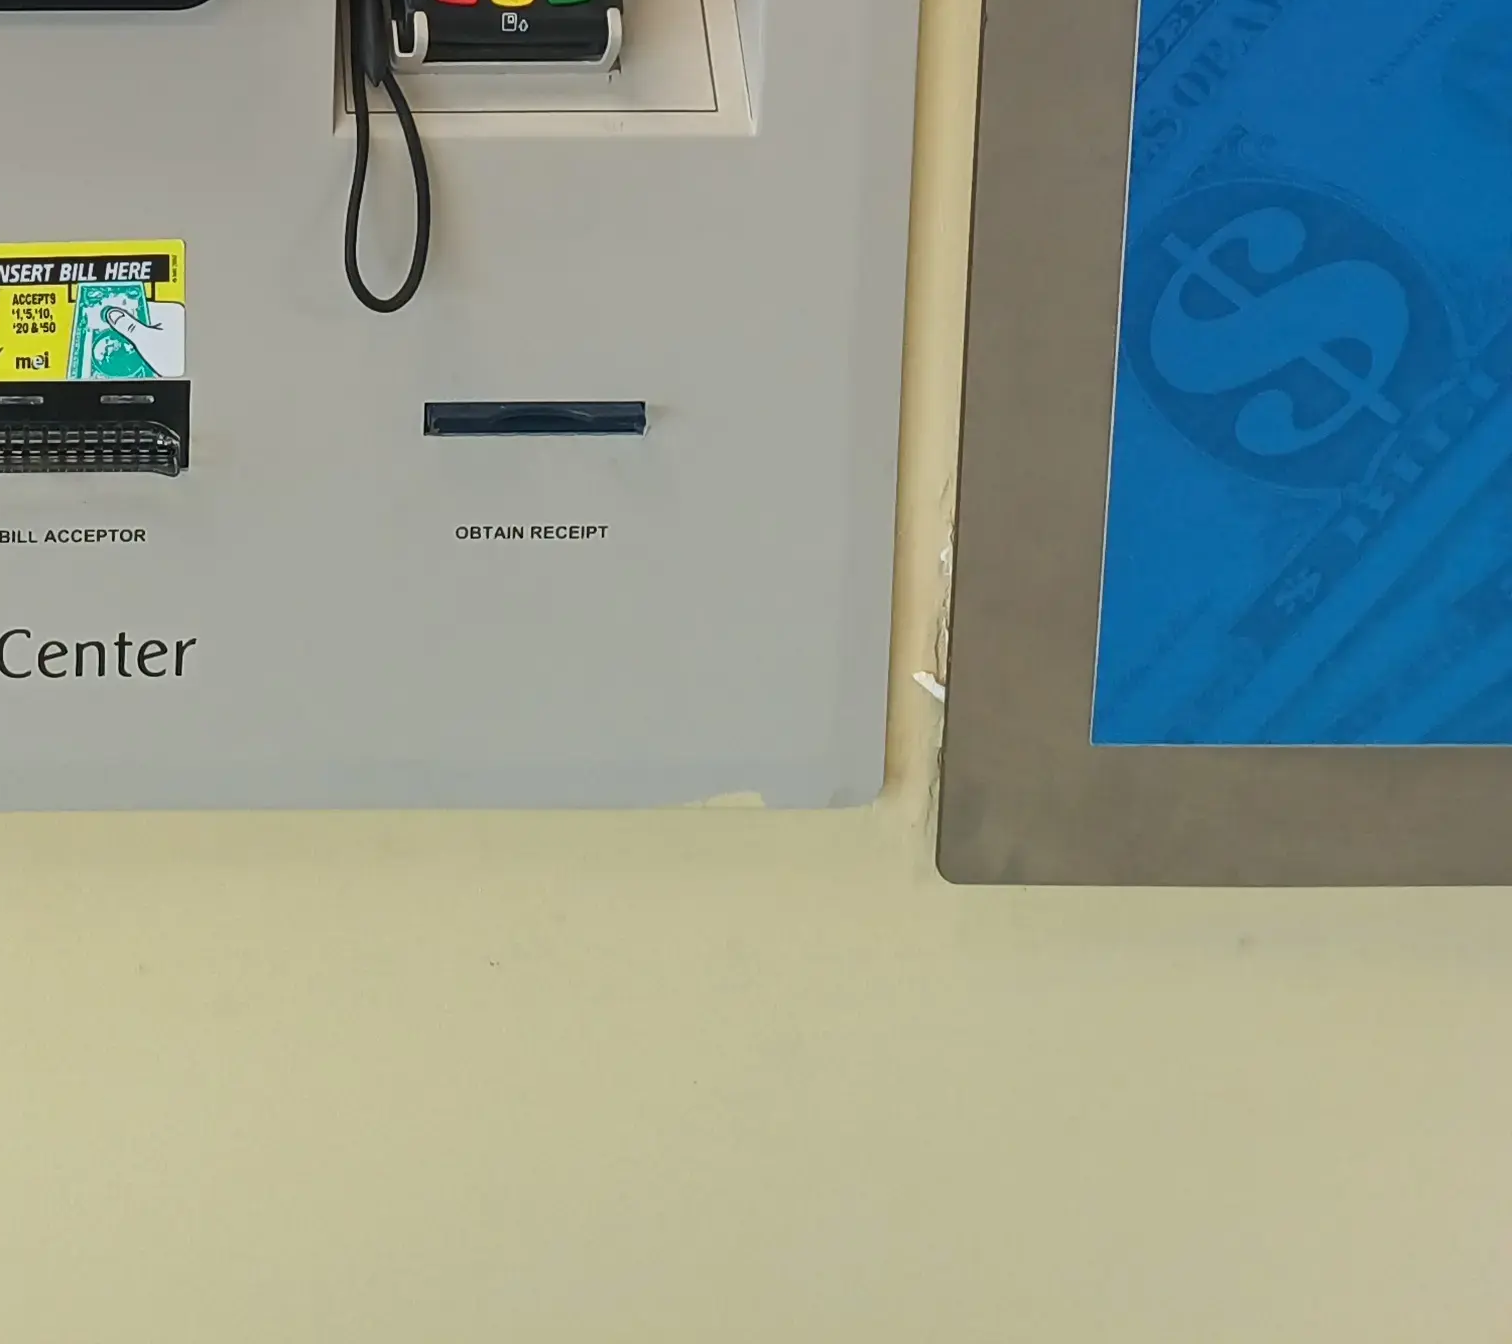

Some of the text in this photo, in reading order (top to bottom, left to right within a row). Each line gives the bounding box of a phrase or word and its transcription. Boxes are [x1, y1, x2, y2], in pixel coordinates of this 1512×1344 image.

[59, 262, 97, 281] BILL
[105, 261, 152, 281] HERE
[12, 293, 56, 305] ACCEPTS
[31, 323, 39, 334] &
[15, 351, 50, 370] mei
[44, 528, 146, 543] ACCEPTOR
[454, 524, 609, 541] OBTAIN RECEIPT
